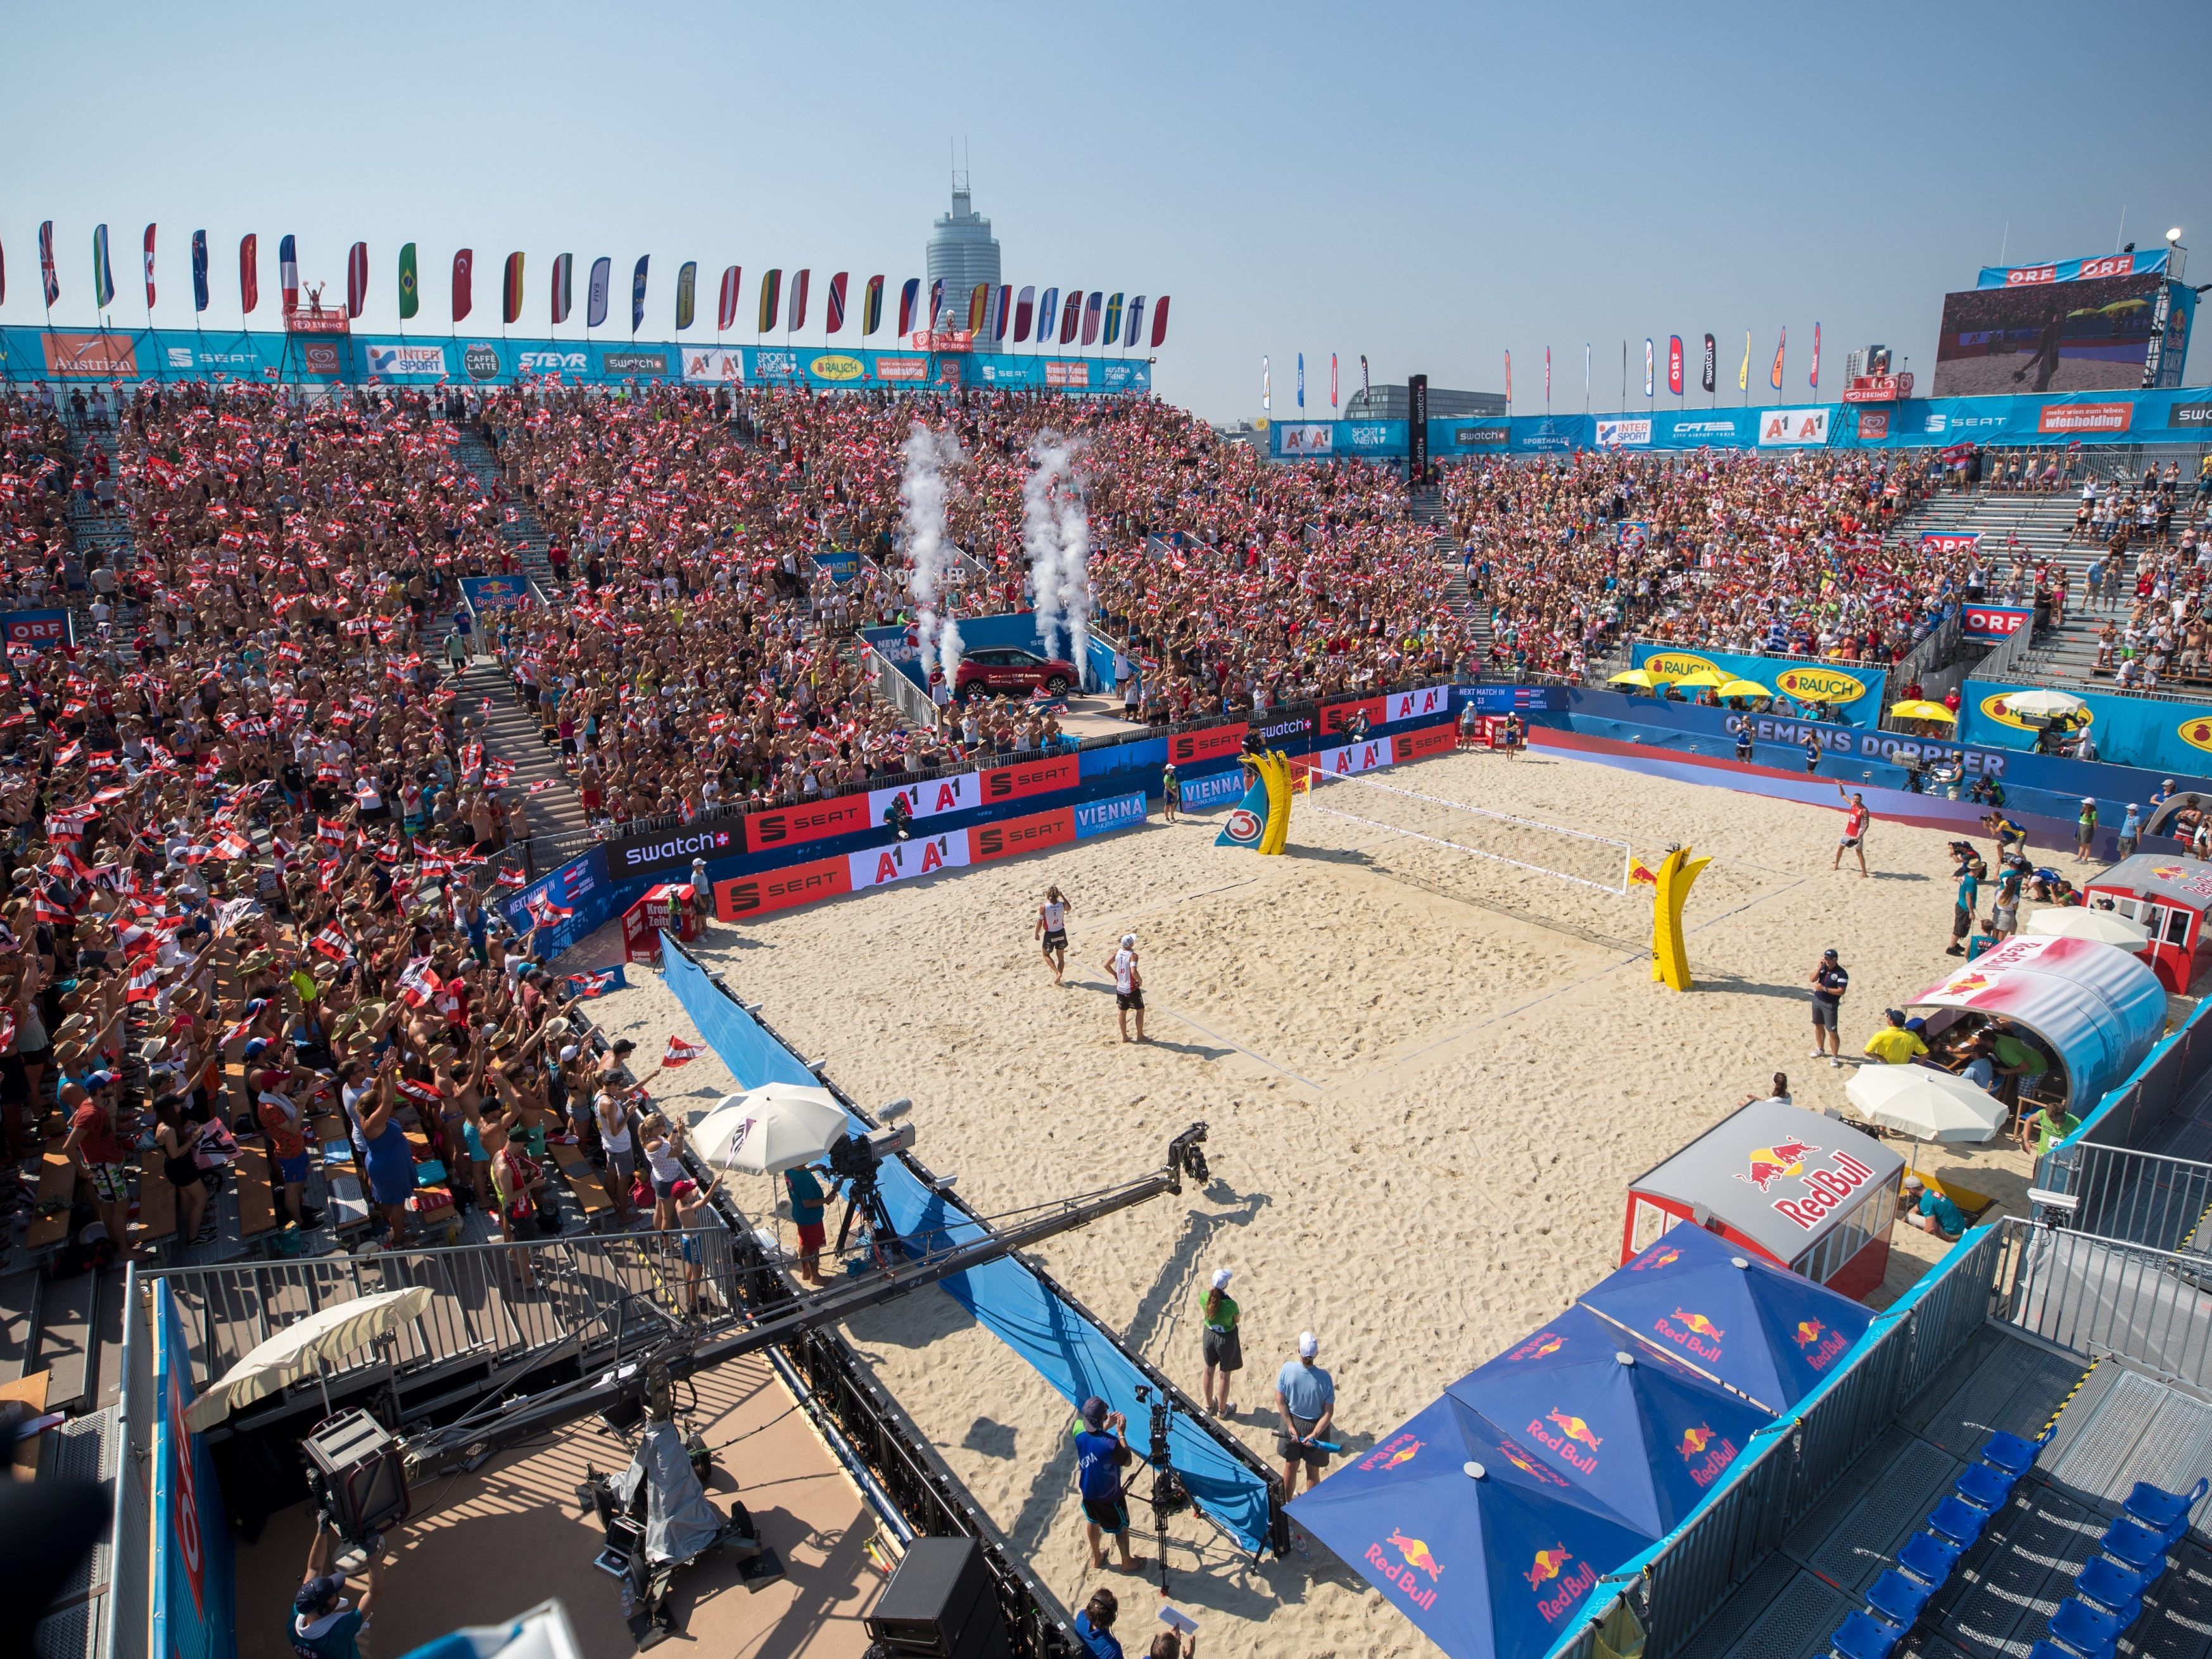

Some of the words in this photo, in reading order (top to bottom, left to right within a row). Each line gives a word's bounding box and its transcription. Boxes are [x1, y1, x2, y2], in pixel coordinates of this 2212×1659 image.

[2083, 260, 2130, 275] ORF
[2010, 269, 2053, 284] ORF
[199, 353, 257, 363] SEAT
[399, 350, 439, 360] INTER
[467, 354, 496, 362] CAFFÈ
[520, 353, 586, 367] STEYR
[757, 353, 787, 362] SPORT
[54, 356, 132, 372] Austrian
[400, 360, 440, 371] SPORT
[690, 354, 709, 375] A1
[721, 355, 738, 375] A1
[825, 363, 857, 373] RAUCH
[1046, 365, 1066, 374] Kronen
[1068, 366, 1087, 374] Kronen
[2103, 407, 2126, 415] leben.
[1618, 423, 1648, 432] INTER
[1767, 417, 1788, 438] A1
[1800, 415, 1823, 438] A1
[1952, 417, 2006, 427] SEAT
[1287, 429, 1304, 448] A1
[1311, 429, 1329, 448] A1
[1353, 427, 1377, 436] SPORT
[1460, 431, 1498, 440] swatch
[1617, 432, 1646, 441] SPORT
[474, 596, 496, 607] Red
[498, 593, 518, 605] Bull
[14, 623, 60, 638] ORF
[1969, 614, 2022, 631] ORF
[878, 638, 901, 648] NEW
[1800, 677, 1854, 696] RAUCH
[1400, 696, 1415, 718] A1
[1424, 688, 1438, 713] A1
[1345, 707, 1379, 718] SAT
[1260, 719, 1303, 738] swatch
[1726, 716, 1852, 752] CEMENS
[1199, 734, 1240, 749] SEAT
[1416, 734, 1450, 749] SEAT
[1336, 747, 1353, 774] A1
[1363, 741, 1380, 769] A1
[1018, 767, 1069, 785] SEAT
[935, 778, 959, 811] A1
[1185, 776, 1242, 801] VIENNA
[794, 808, 857, 830] SEAT
[1078, 798, 1143, 826] VIENNA
[1009, 821, 1065, 842] SEAT
[626, 833, 714, 864] swatch
[921, 835, 947, 873] A1
[576, 859, 588, 871] DOPPLER
[577, 867, 586, 877] HORST
[875, 845, 903, 884] A1
[768, 871, 837, 897] SEAT
[509, 897, 526, 915] NEXT
[549, 880, 555, 891] IN
[627, 909, 641, 926] Kronen
[647, 903, 669, 915] Kron
[628, 920, 643, 940] Zeitung
[648, 916, 669, 927] Zeitu
[1774, 1178, 1833, 1229] Red
[1810, 1150, 1873, 1202] Bull
[910, 1278, 922, 1287] GF-8
[1653, 1318, 1689, 1345] Red
[1685, 1335, 1722, 1363] Bull
[1806, 1347, 1828, 1371] Red
[1823, 1333, 1847, 1357] Bull
[469, 1445, 482, 1454] GFM
[1526, 1420, 1565, 1453] Red
[1558, 1442, 1599, 1476] Bull
[1690, 1460, 1715, 1487] Red
[1708, 1439, 1738, 1470] Bull
[1365, 1543, 1405, 1582] Red
[1399, 1570, 1438, 1612] Bull
[1537, 1584, 1570, 1623] Red
[1561, 1561, 1596, 1603] Bull
